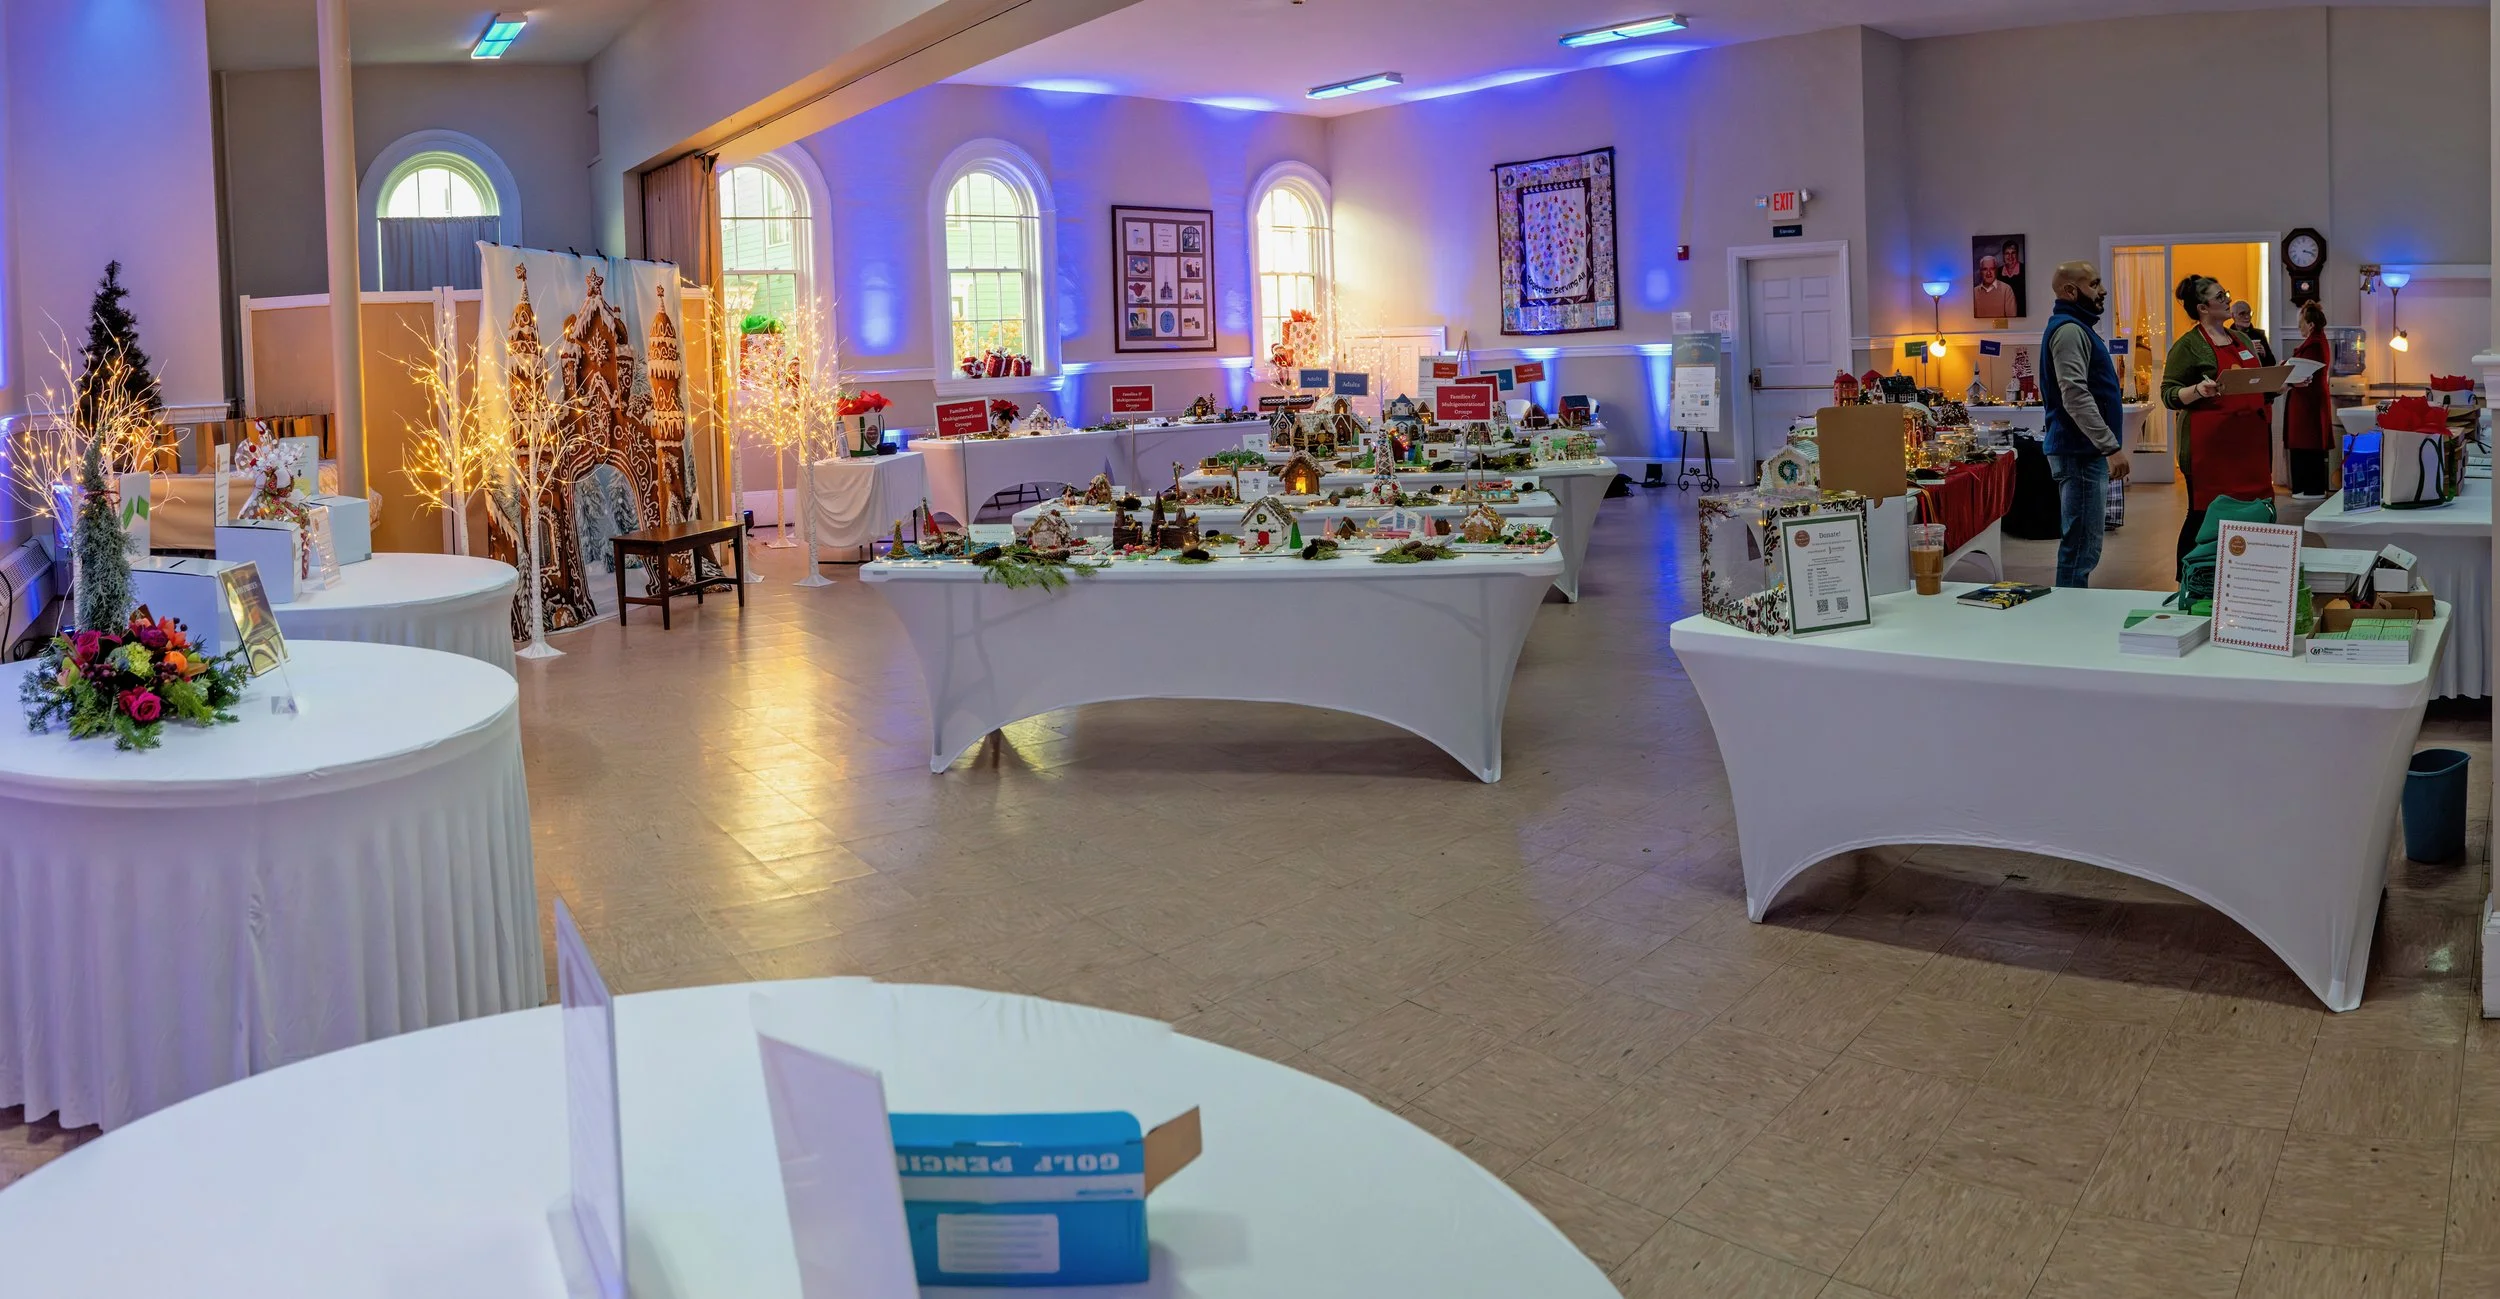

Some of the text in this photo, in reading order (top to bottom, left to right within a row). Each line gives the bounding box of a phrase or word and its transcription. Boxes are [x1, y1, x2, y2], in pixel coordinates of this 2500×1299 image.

[1773, 191, 1795, 211] EXIT
[1527, 271, 1587, 294] Together Serving All
[1441, 401, 1486, 409] Multigenerational
[949, 407, 969, 415] Families
[942, 412, 983, 422] Multigenerational
[954, 421, 972, 429] Groups
[1818, 531, 1841, 539] Donate!
[1033, 1152, 1120, 1173] GOLF
